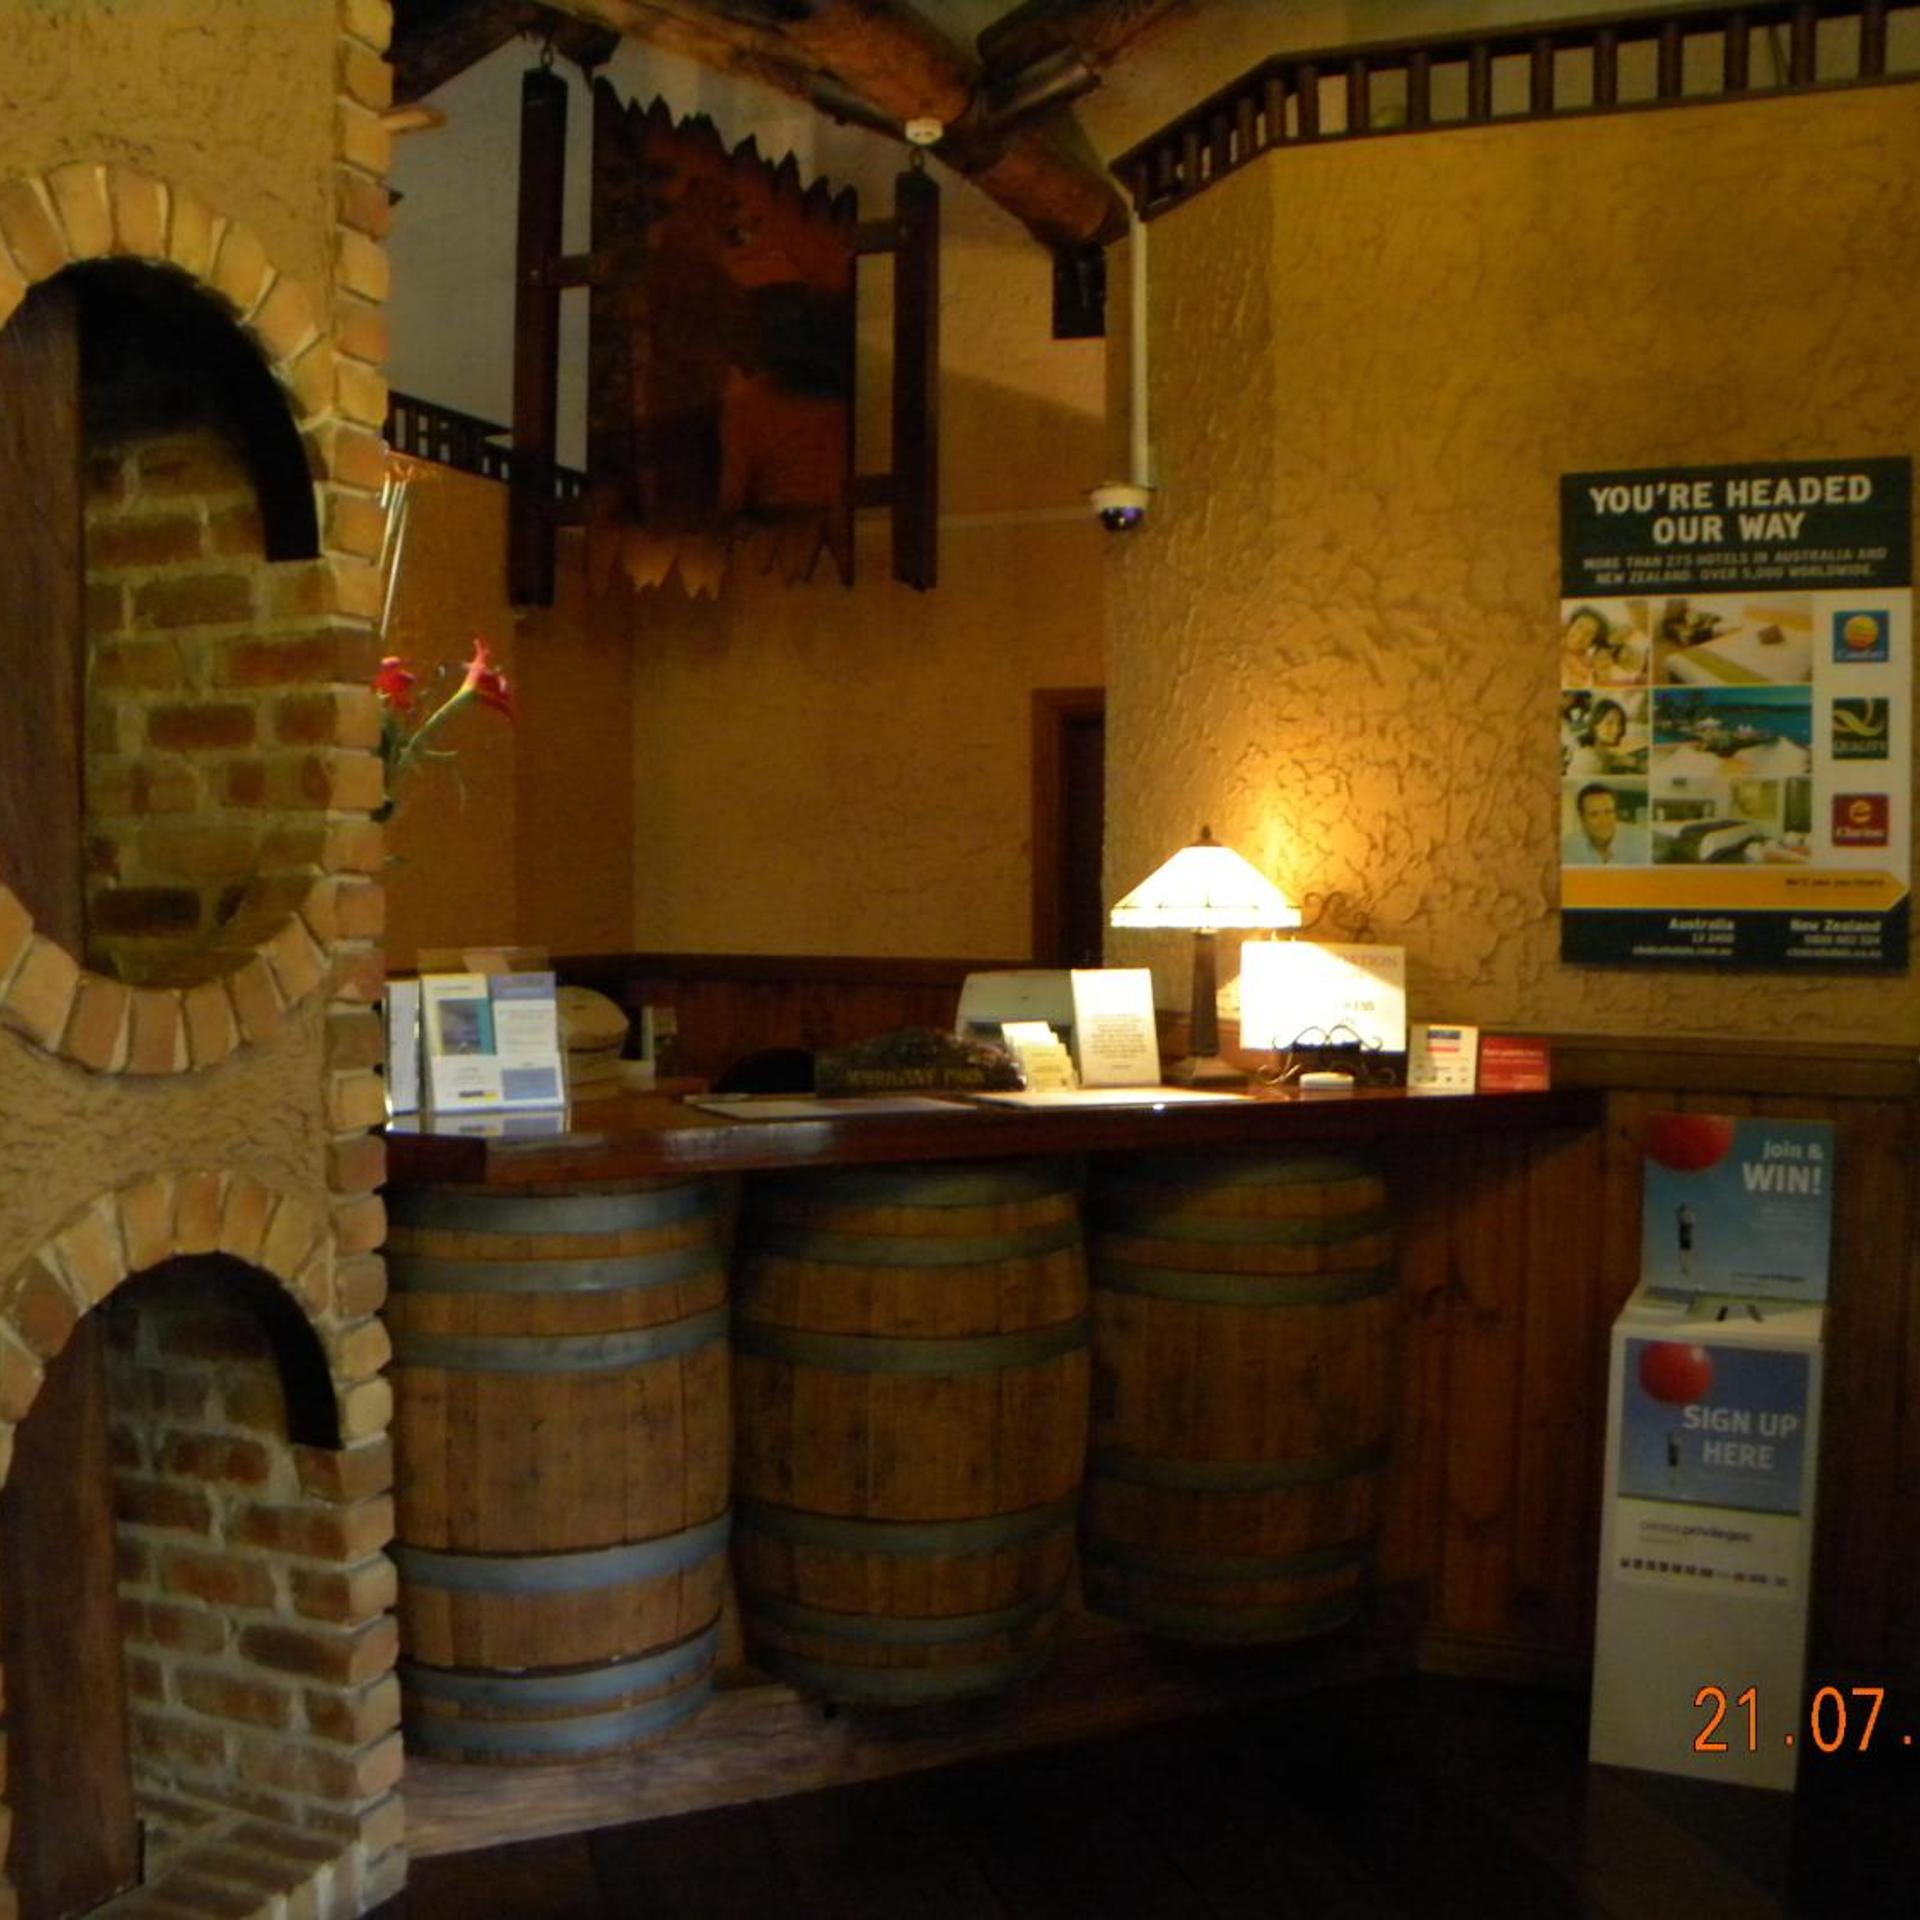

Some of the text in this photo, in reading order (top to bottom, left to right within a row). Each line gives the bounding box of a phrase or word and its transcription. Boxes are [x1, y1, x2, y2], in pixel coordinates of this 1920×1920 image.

[1589, 474, 1873, 514] YOU'RE HEADED
[1653, 511, 1805, 545] OUR WAY
[1625, 554, 1664, 569] THAN
[1695, 551, 1749, 567] HOTELS
[1752, 550, 1769, 564] IN
[1773, 547, 1853, 564] AUSTRALIA
[1594, 571, 1626, 585] NEW
[1668, 917, 1736, 931] Australia
[1789, 918, 1883, 933] New Zealand
[1807, 1143, 1823, 1160] &
[1742, 1162, 1822, 1195] WIN!
[1682, 1404, 1798, 1438] SIGN UP
[1702, 1440, 1775, 1470] HERE
